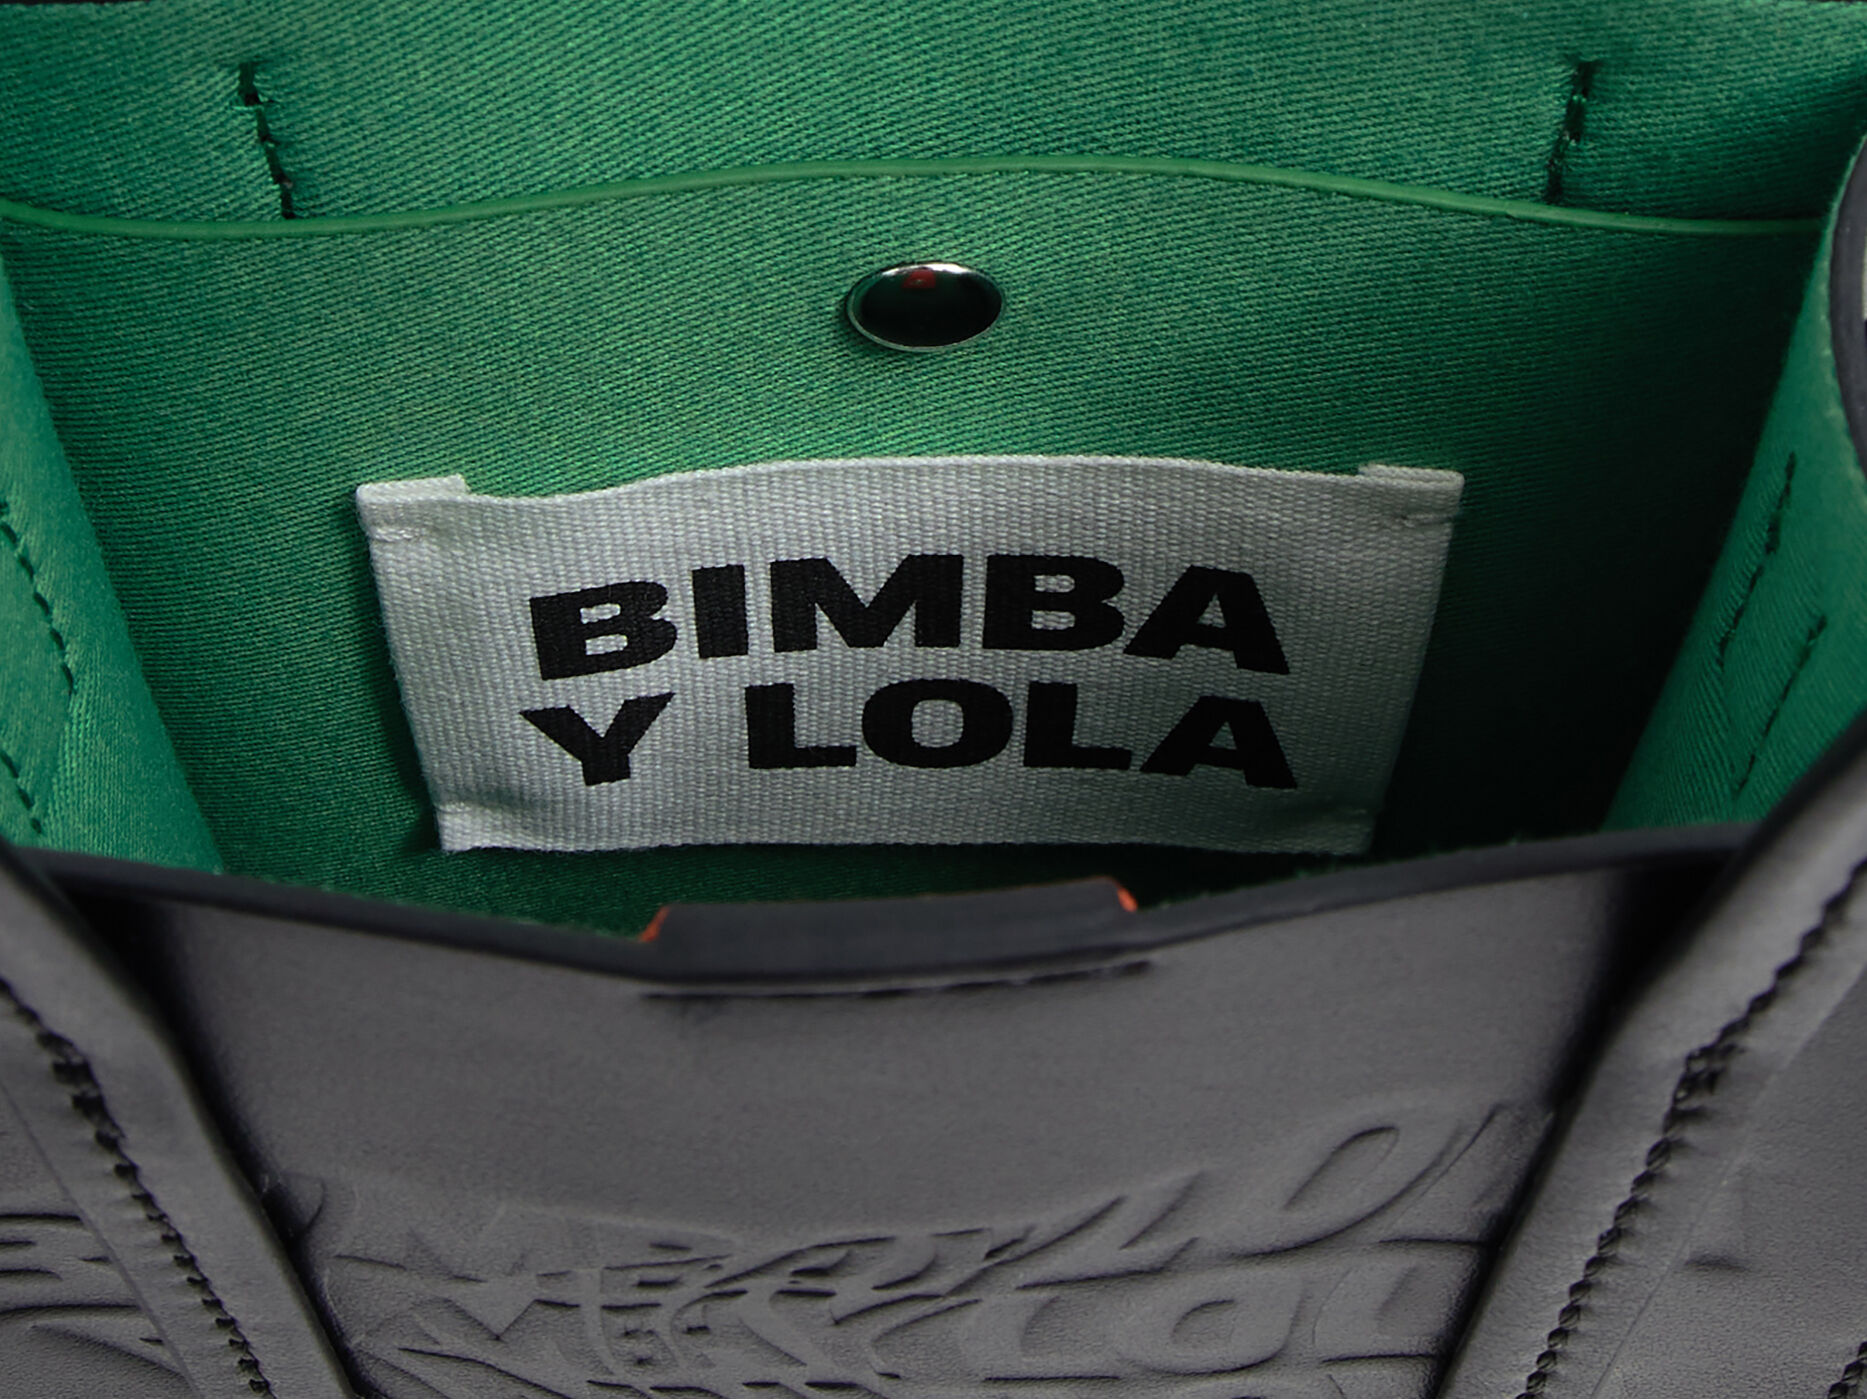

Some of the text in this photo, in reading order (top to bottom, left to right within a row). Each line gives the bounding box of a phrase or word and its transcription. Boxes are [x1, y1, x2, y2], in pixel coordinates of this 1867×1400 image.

[529, 553, 1290, 681] BIMBA
[519, 678, 1298, 790] Y LOLA
